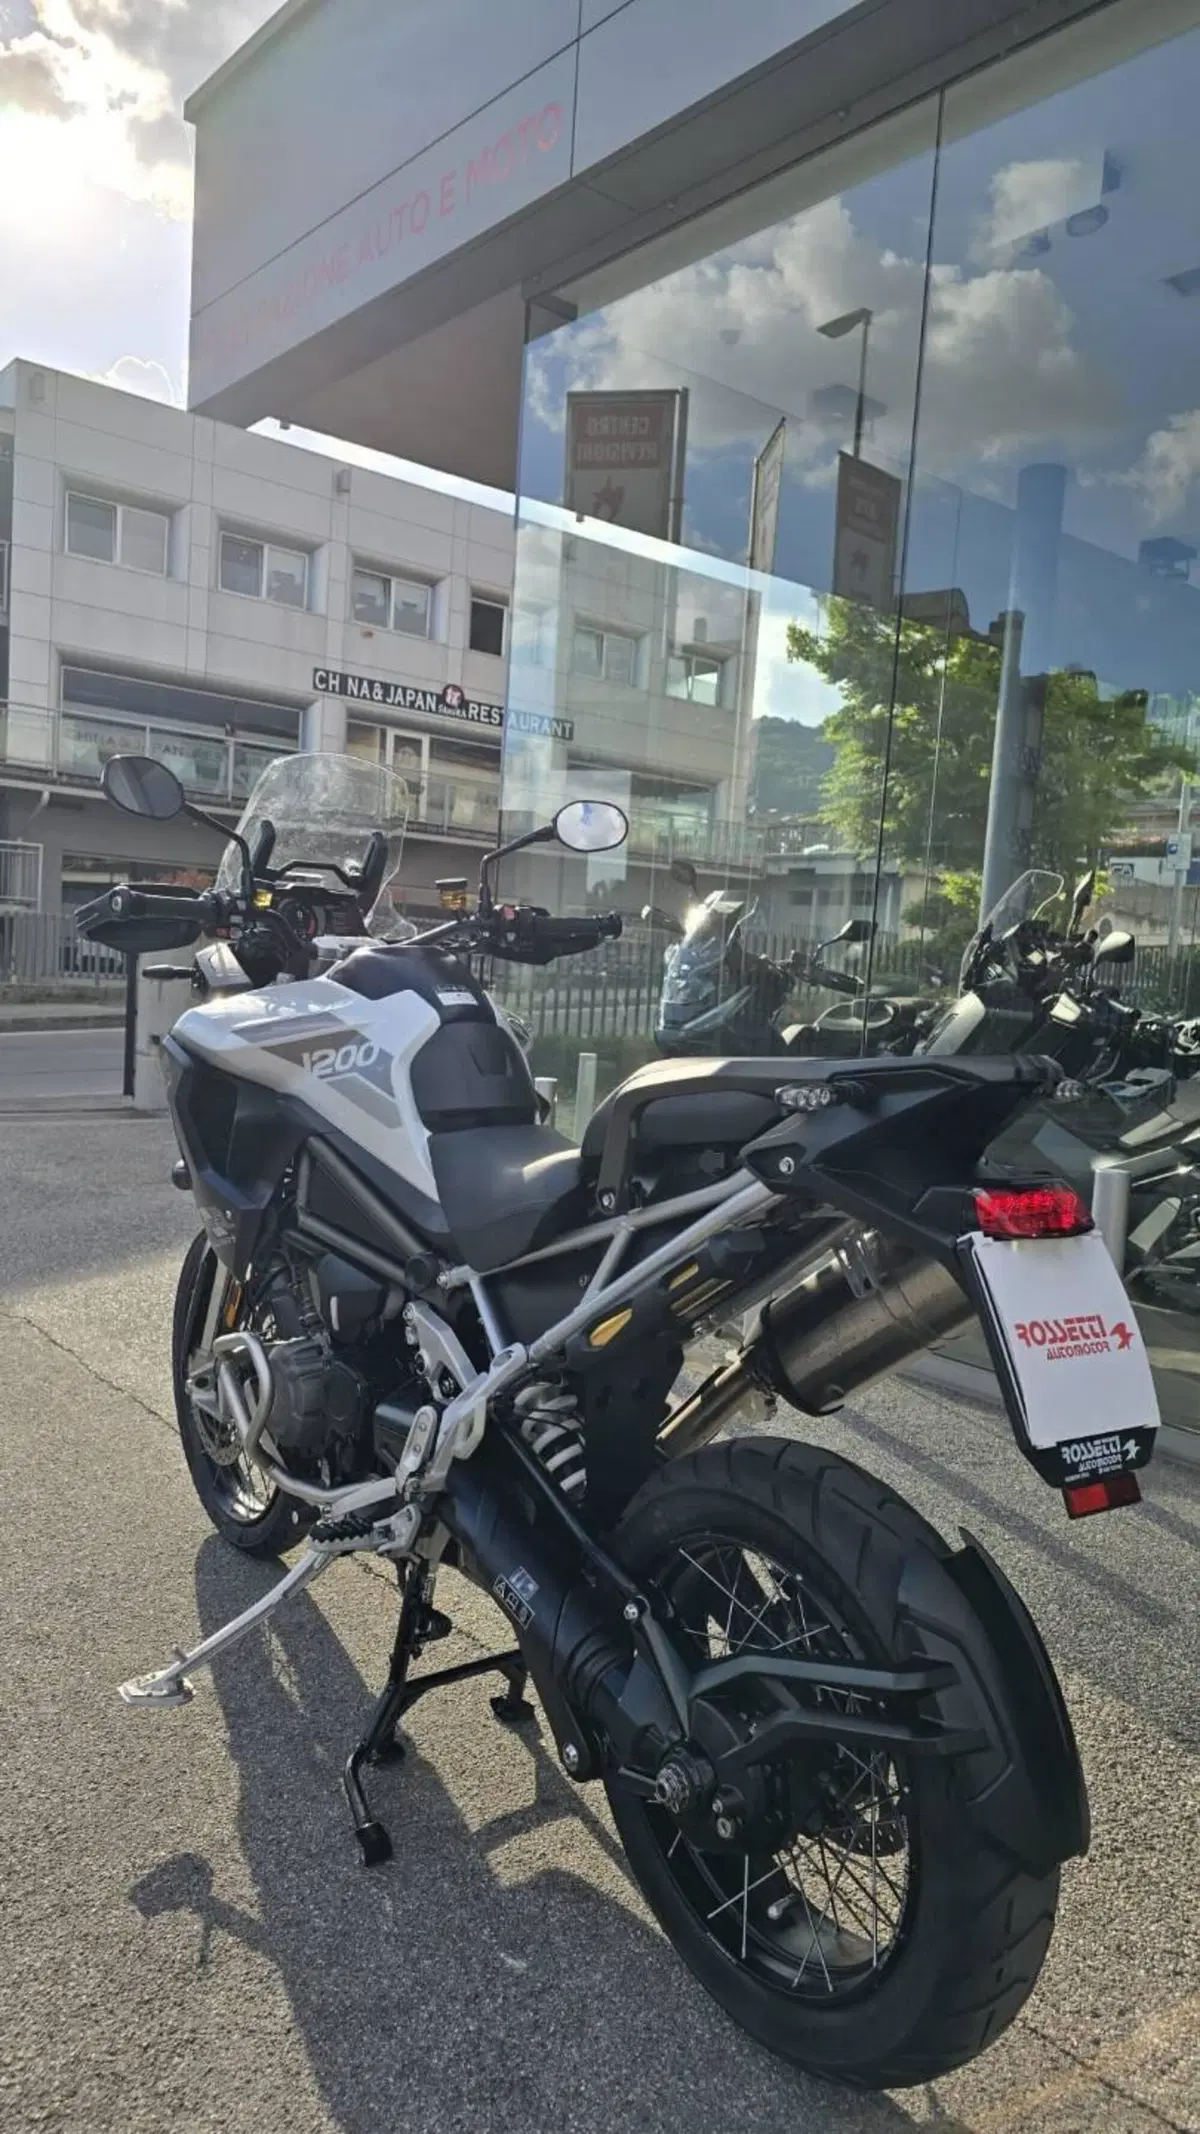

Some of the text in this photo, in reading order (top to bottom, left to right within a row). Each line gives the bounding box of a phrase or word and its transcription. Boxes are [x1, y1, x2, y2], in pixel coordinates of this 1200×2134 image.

[355, 101, 566, 269] AUTO E MOTO
[468, 702, 573, 739] RESAURANT
[301, 1042, 382, 1075] 1200
[1014, 1315, 1107, 1348] ROSSETTI
[1046, 1340, 1111, 1360] AUTOMOTOR
[1061, 1435, 1120, 1464] ROSSETTI
